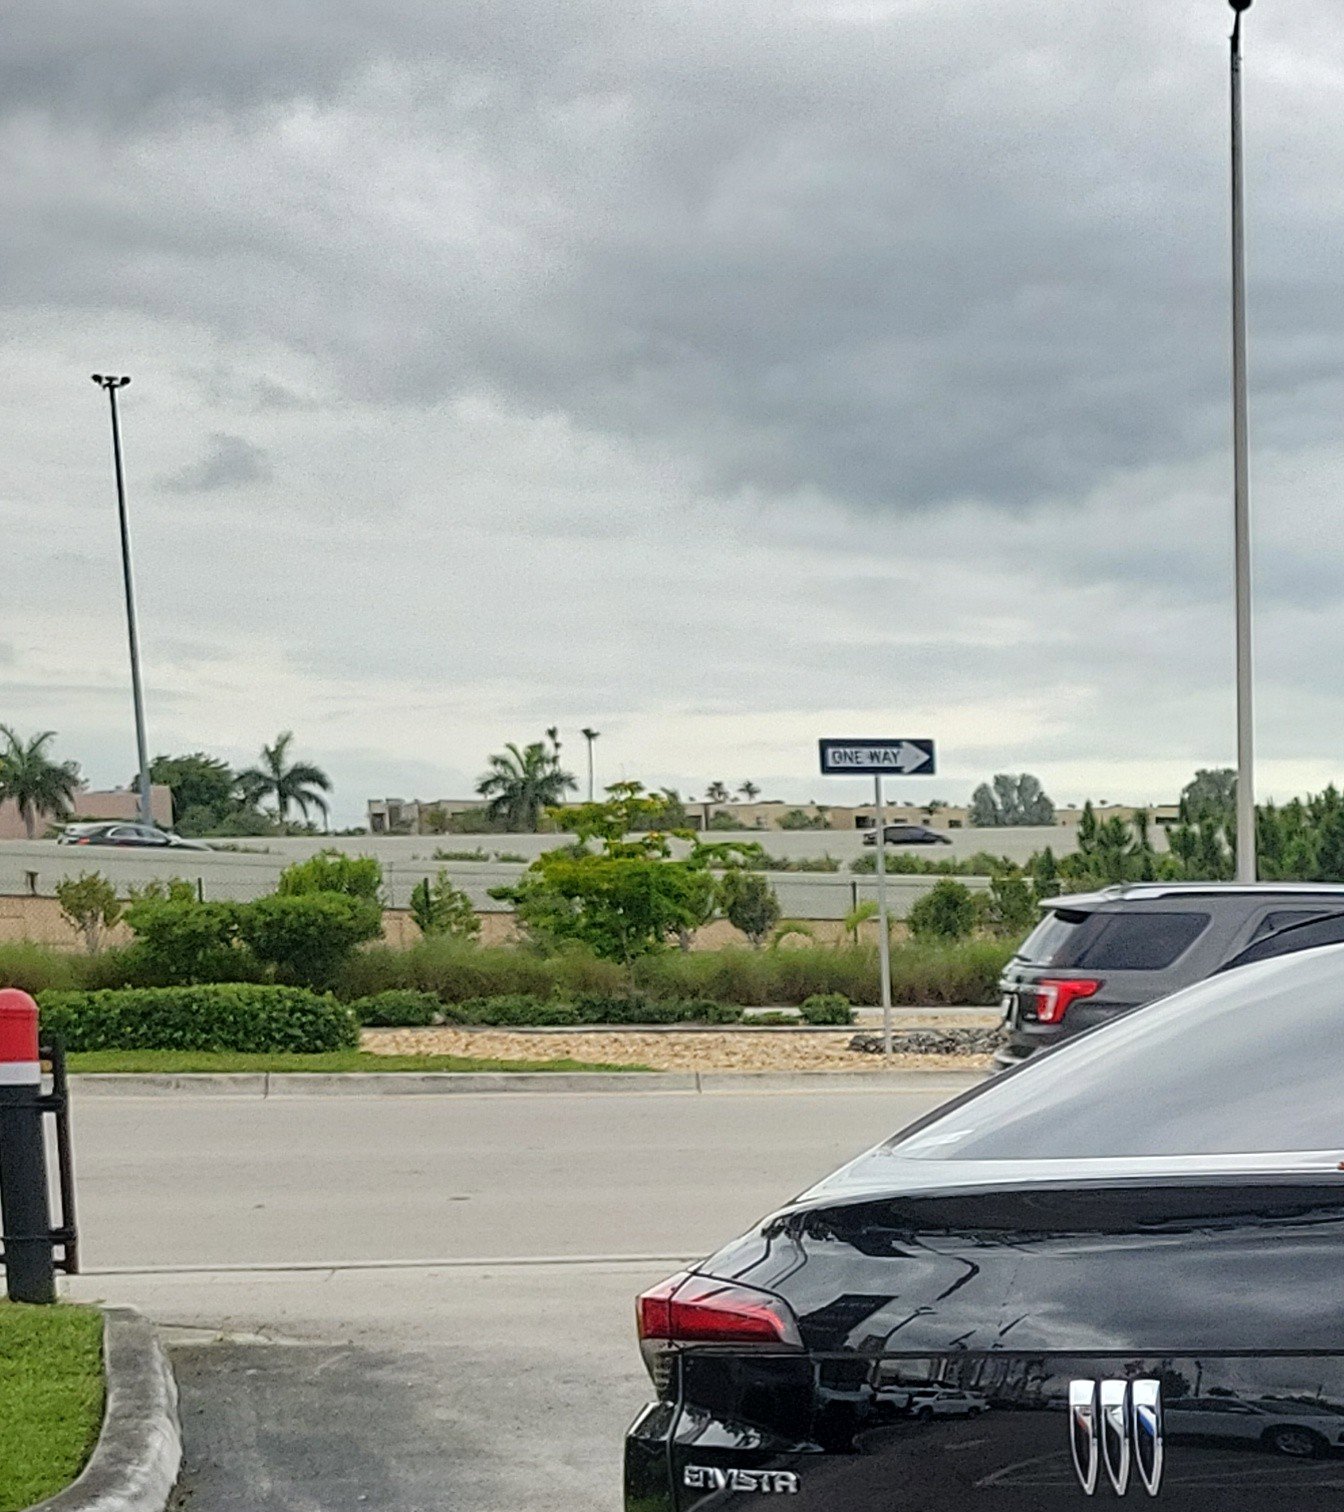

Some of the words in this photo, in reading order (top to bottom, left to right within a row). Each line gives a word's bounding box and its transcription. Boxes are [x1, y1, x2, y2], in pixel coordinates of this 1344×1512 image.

[831, 750, 863, 765] ONE
[868, 750, 900, 764] WAY
[684, 1465, 799, 1493] ENVISTA
